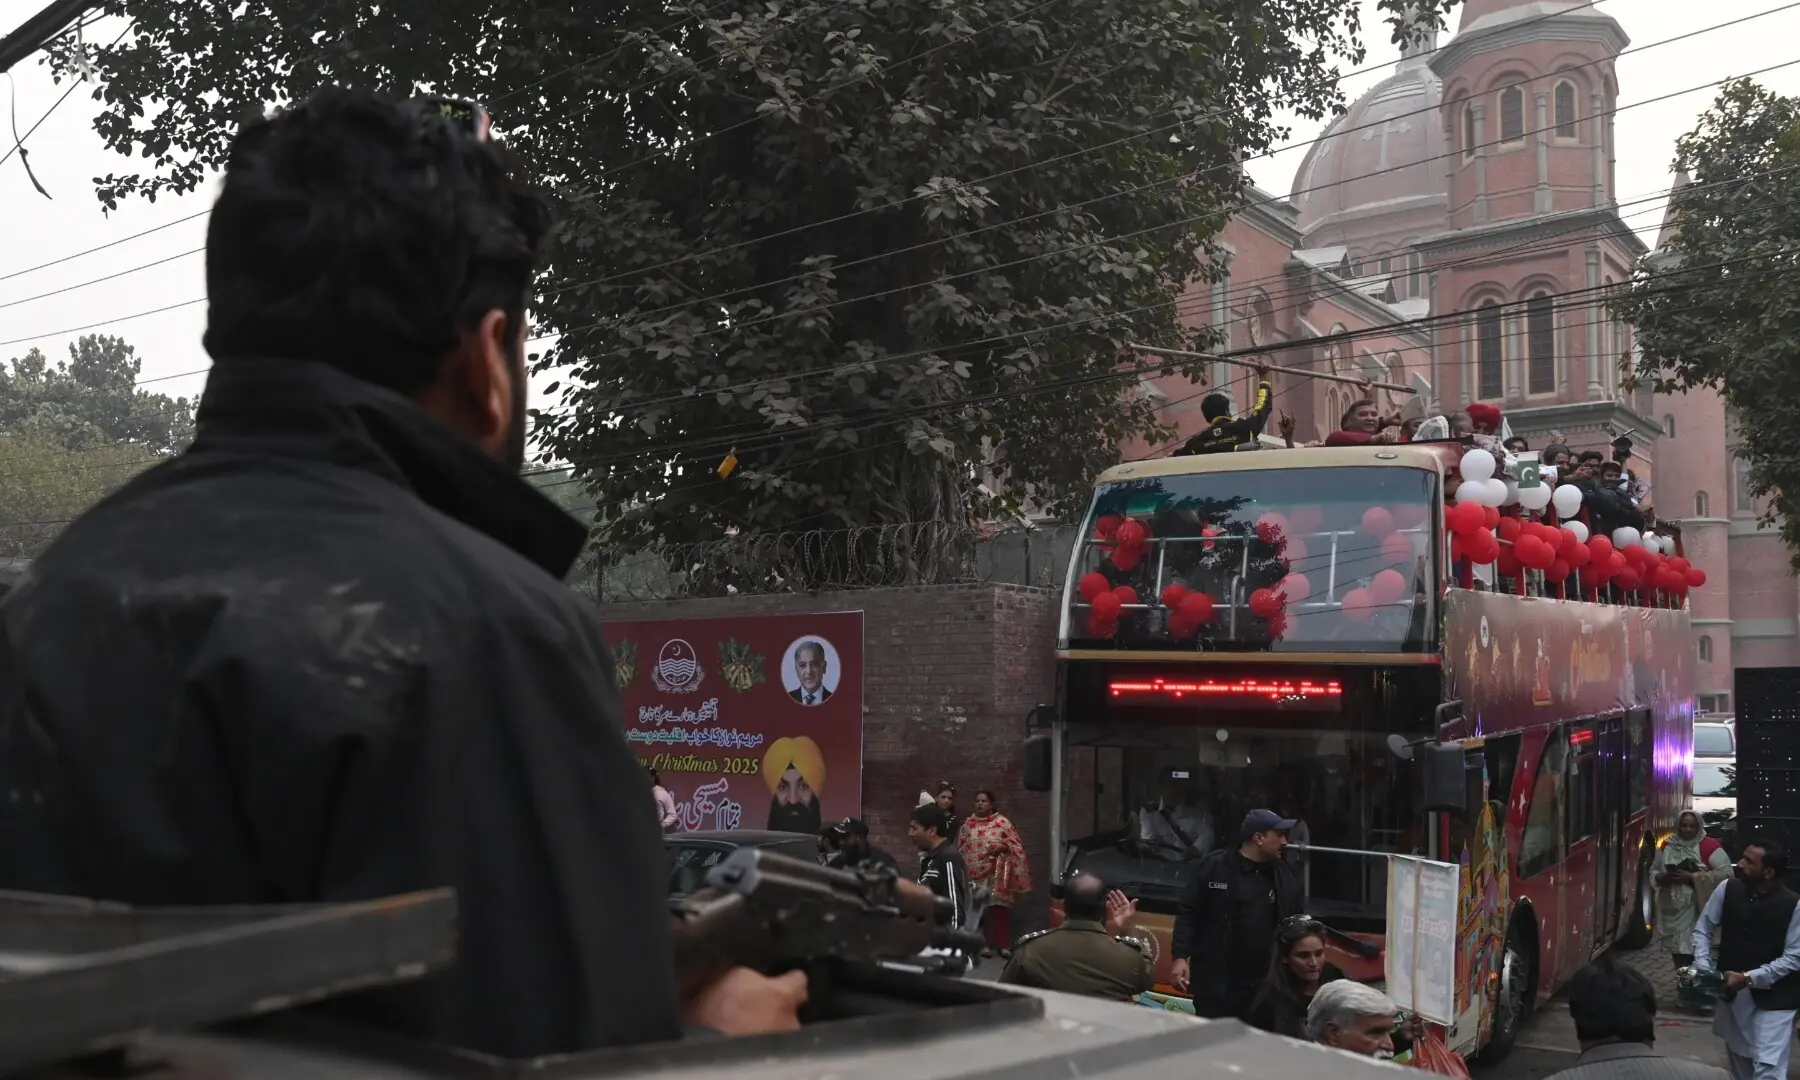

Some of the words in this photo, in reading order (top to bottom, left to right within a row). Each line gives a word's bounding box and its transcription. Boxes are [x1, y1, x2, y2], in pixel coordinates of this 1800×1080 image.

[638, 706, 655, 724] تاج
[665, 706, 694, 722] ہمارے
[628, 727, 658, 746] دوست
[657, 726, 686, 746] اقلیت
[685, 727, 712, 747] خواب
[710, 726, 722, 743] کا
[717, 727, 738, 748] نواز
[736, 732, 764, 750] مریم
[651, 752, 719, 776] Christmas
[722, 757, 759, 774] 2025
[683, 777, 729, 832] مسیحی
[715, 797, 742, 832] تمام
